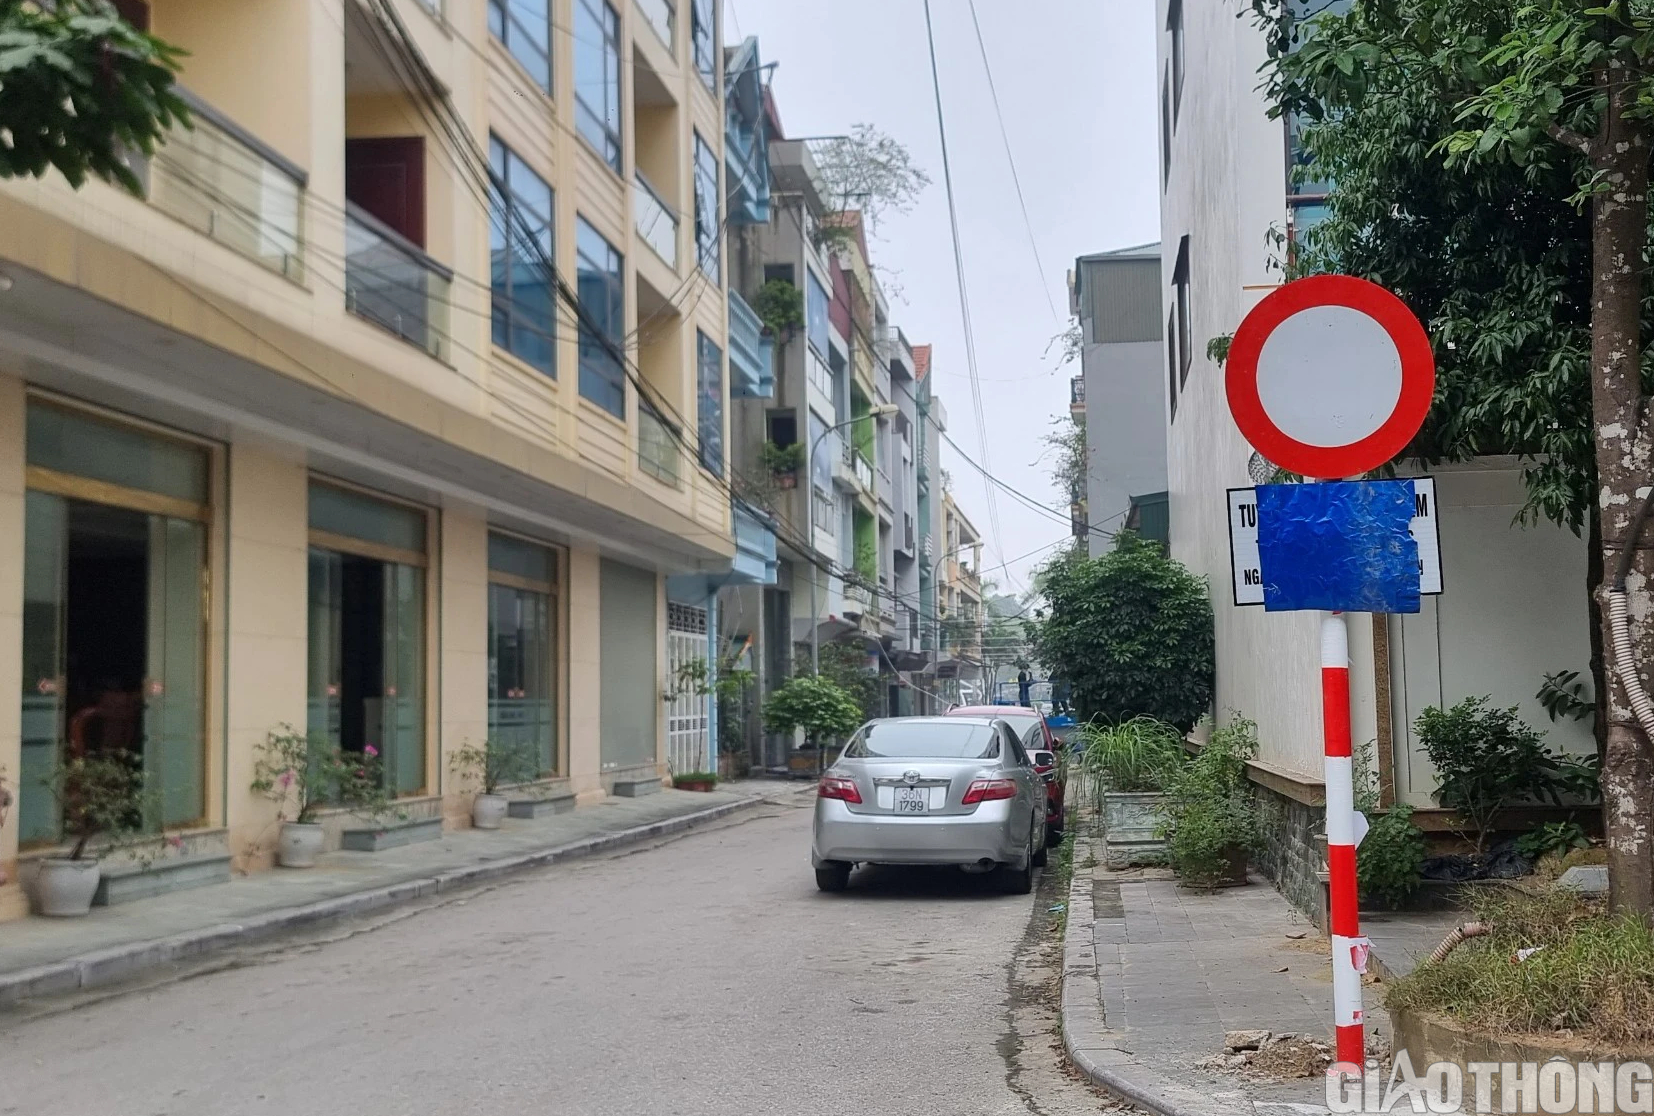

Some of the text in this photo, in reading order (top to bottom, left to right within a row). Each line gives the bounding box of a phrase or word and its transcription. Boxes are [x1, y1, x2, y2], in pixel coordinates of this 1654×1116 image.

[1238, 503, 1258, 528] TU
[1243, 568, 1263, 586] NG
[901, 789, 923, 800] 36N
[899, 800, 924, 811] 1799
